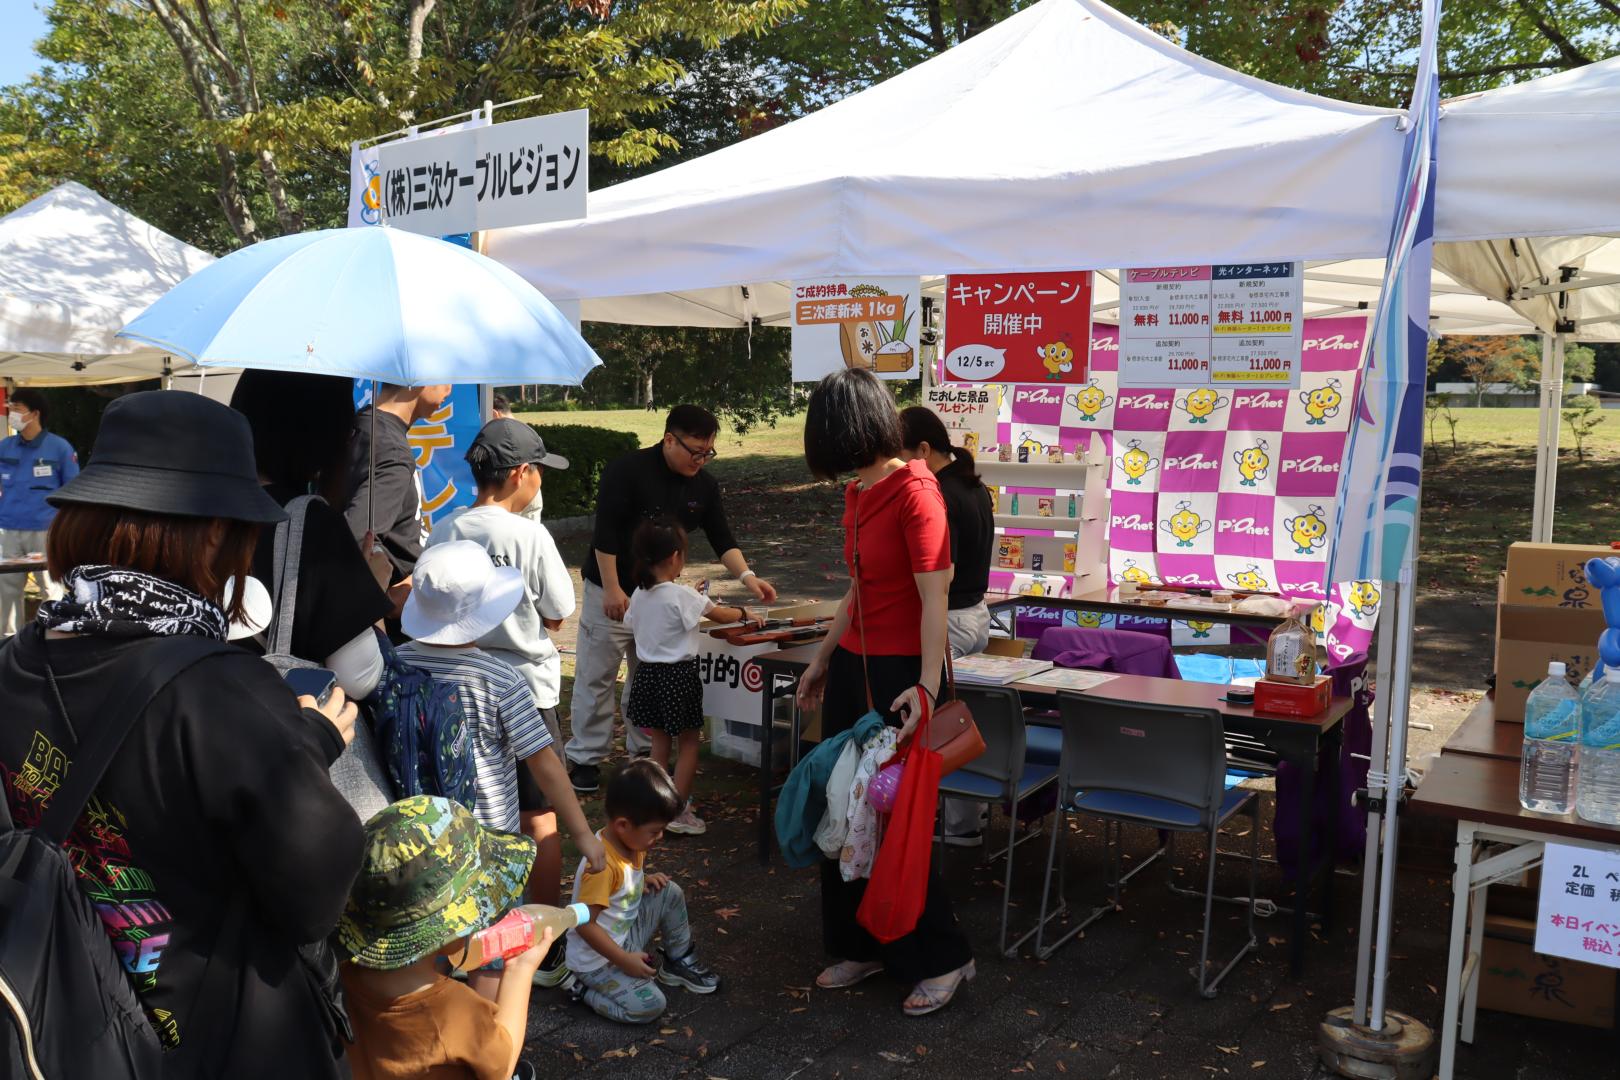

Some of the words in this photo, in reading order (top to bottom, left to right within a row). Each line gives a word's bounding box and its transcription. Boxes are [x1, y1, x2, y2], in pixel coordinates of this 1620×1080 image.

[385, 143, 581, 217] (株)三次ケーブルビジョン
[1130, 267, 1200, 280] ケーブルテレビ
[1218, 264, 1289, 276] 光インターネット
[795, 283, 848, 299] ご成約特典
[951, 281, 1081, 306] キャンペーン
[800, 302, 864, 321] 三次産新米
[868, 301, 897, 317] 1kg
[1218, 310, 1244, 324] 無料
[983, 312, 1043, 336] 開催中
[1134, 313, 1160, 326] 無料
[859, 327, 874, 354] お米
[928, 390, 989, 404] たおした景品
[1572, 865, 1590, 878] 2L
[1565, 881, 1595, 897] 定価
[1583, 937, 1613, 955] 税込
